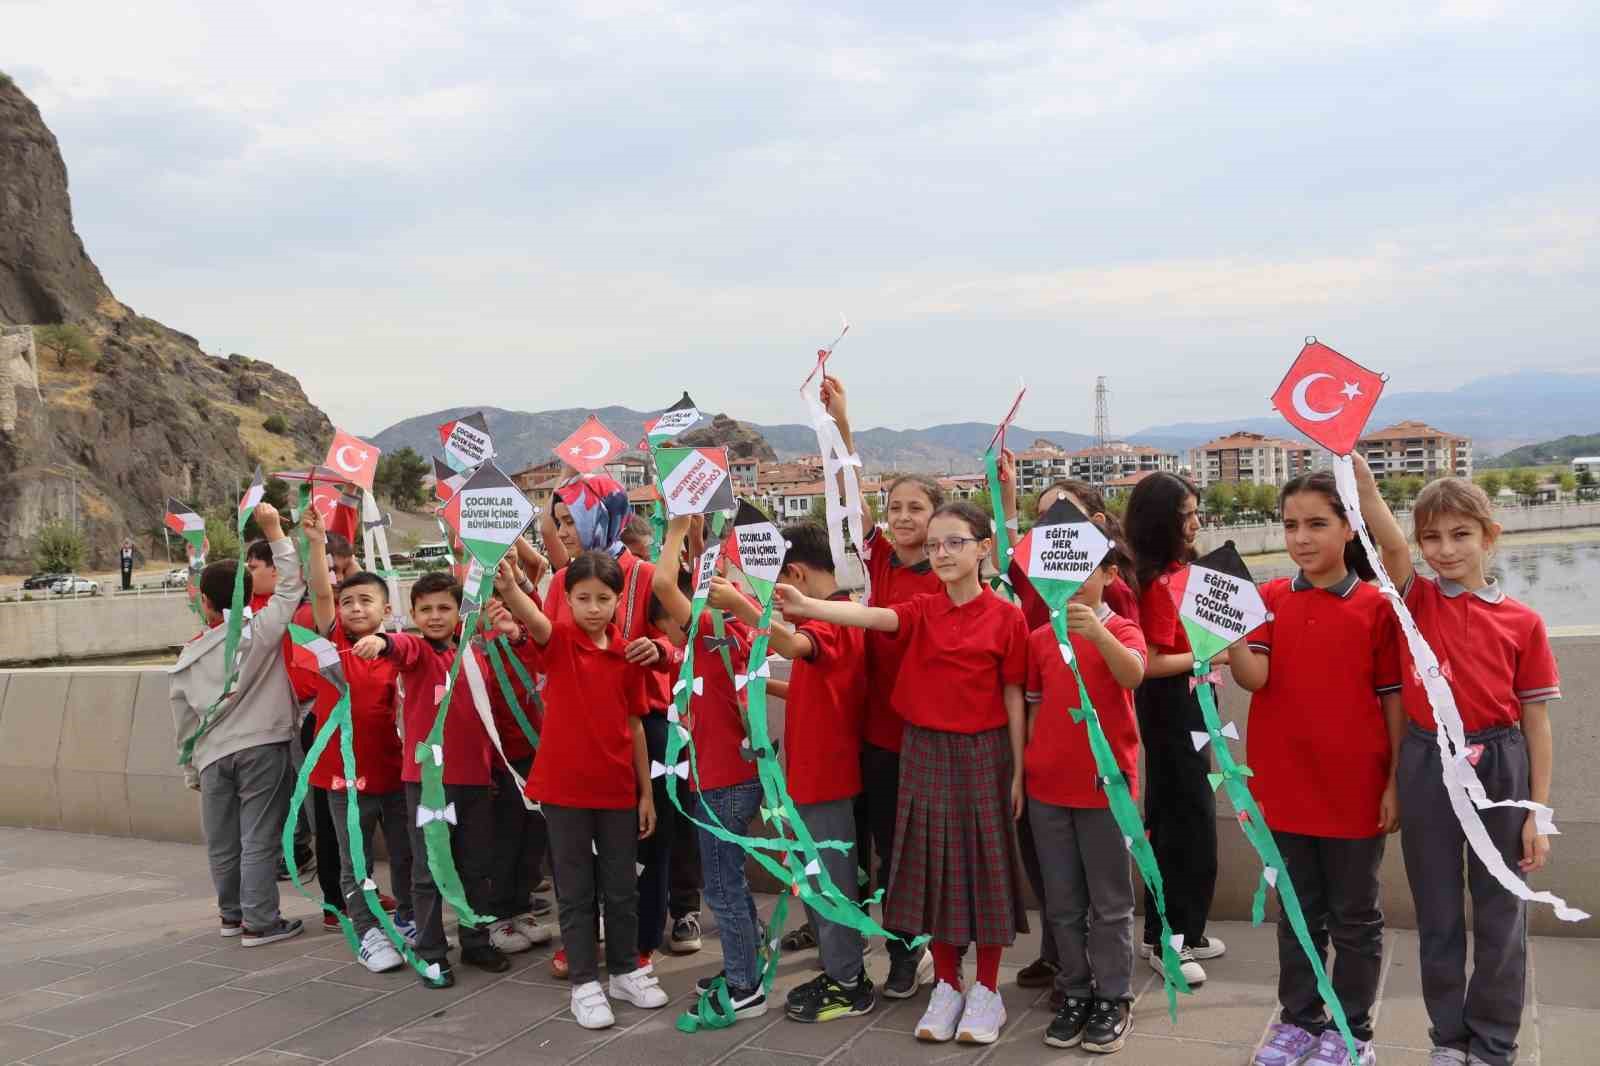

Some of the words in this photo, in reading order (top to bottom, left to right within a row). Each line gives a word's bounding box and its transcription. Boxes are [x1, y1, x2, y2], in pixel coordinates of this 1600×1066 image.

[465, 497, 513, 507] ÇOCUKLAR
[461, 508, 490, 519] GÜVEN
[491, 509, 519, 520] İÇİNDE
[467, 519, 522, 529] BÜYÜMELİDİR!
[739, 532, 771, 542] ÇOCUKLAR
[1045, 527, 1080, 540] EĞİTİM
[756, 543, 778, 556] İÇİNDE
[1052, 540, 1072, 549] HER
[1040, 549, 1089, 562] ÇOCUĞUN
[1043, 561, 1094, 572] HAKKIDIR!
[1203, 573, 1239, 595] EĞİTİM
[1208, 587, 1230, 602] HER
[1194, 593, 1245, 621] ÇOCUĞUN
[1195, 606, 1248, 635] HAKKIDIR!
